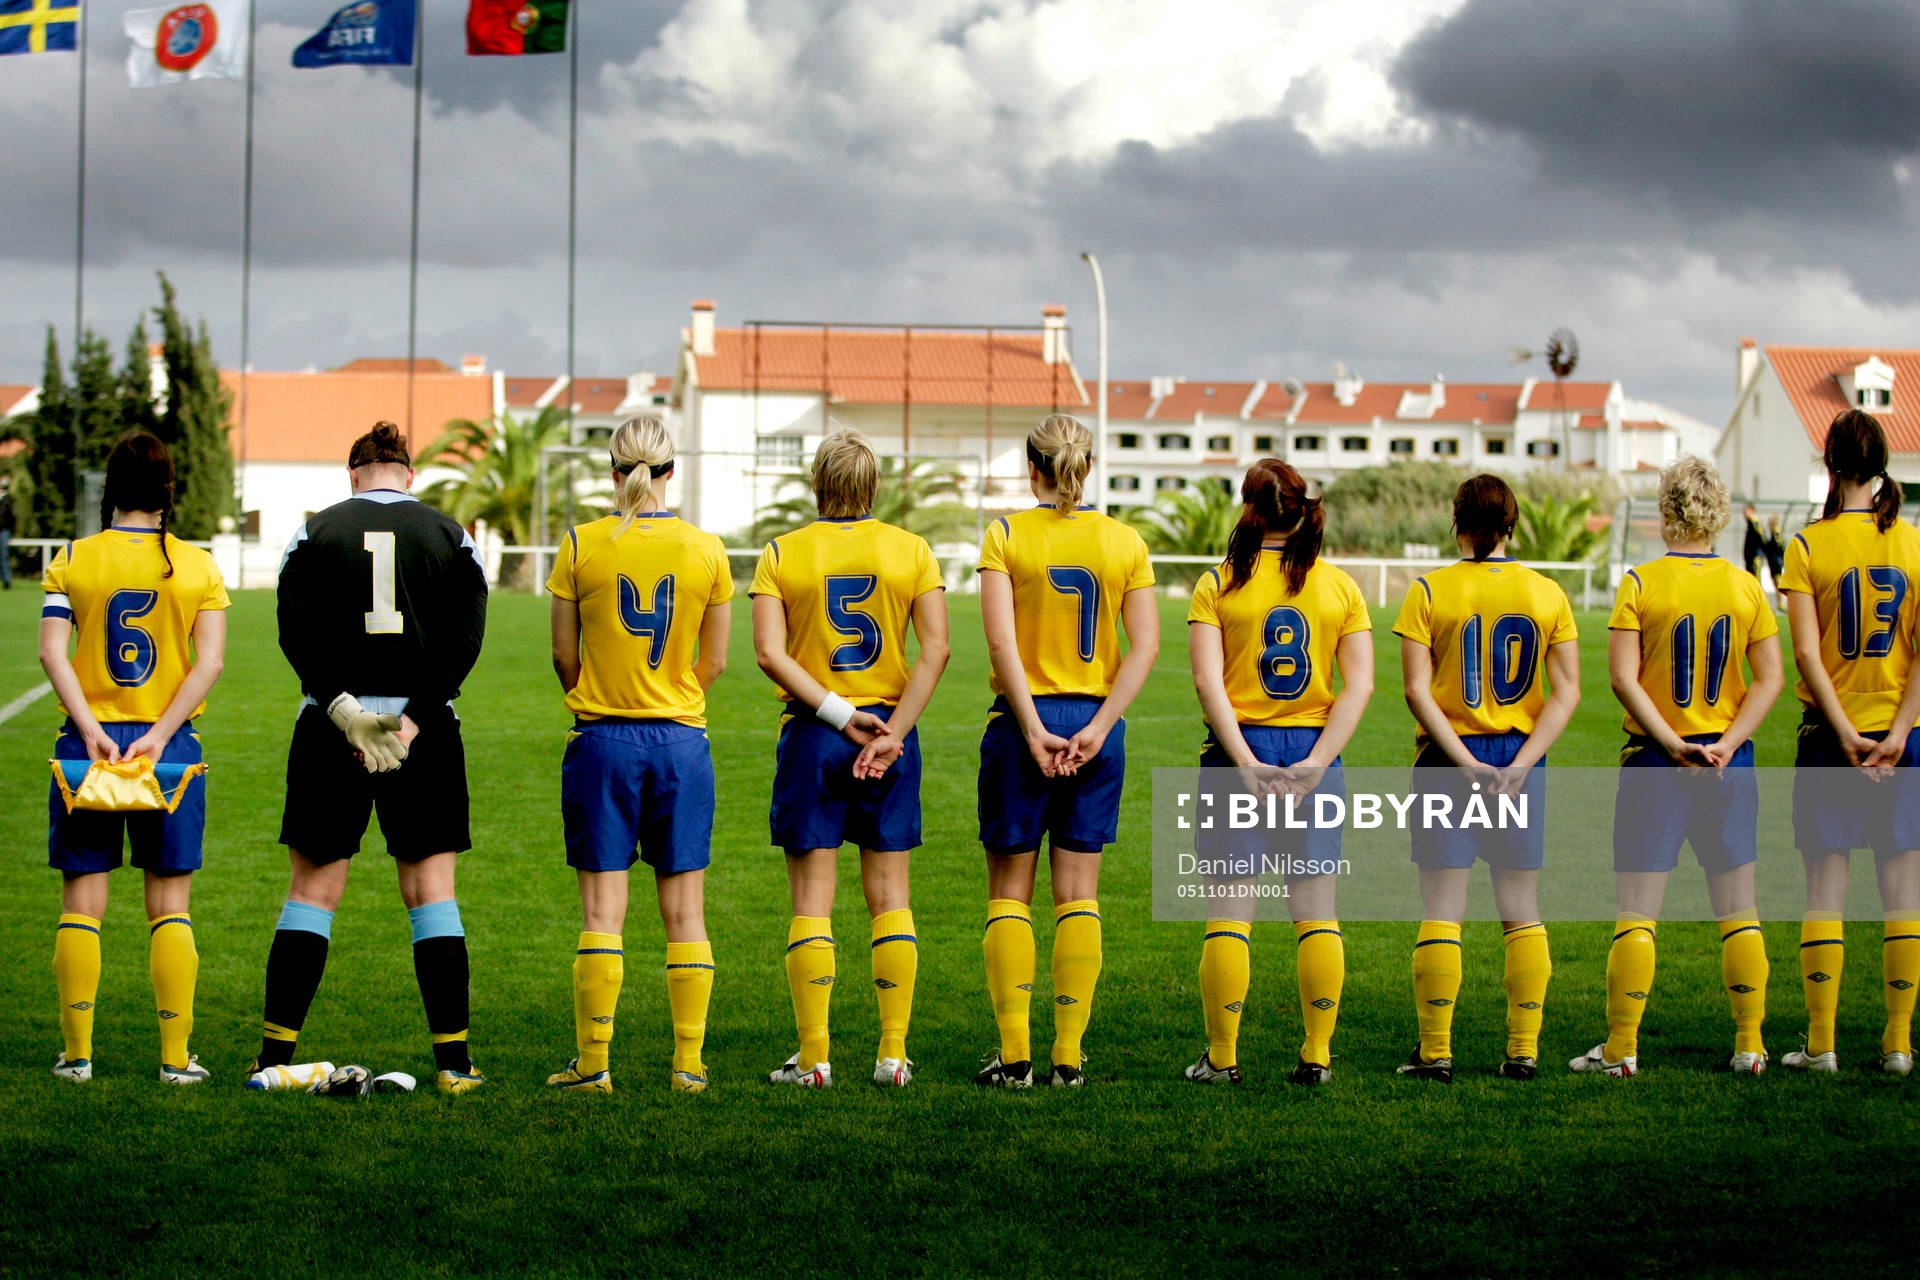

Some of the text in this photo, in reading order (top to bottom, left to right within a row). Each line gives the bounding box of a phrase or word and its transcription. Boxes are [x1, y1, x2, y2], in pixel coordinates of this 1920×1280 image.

[363, 531, 404, 635] 1
[617, 573, 675, 670] 4
[824, 574, 883, 672] 5
[1046, 565, 1101, 663] 7
[1837, 565, 1909, 660] 13
[104, 588, 158, 687] 6
[1257, 605, 1312, 700] 8
[1460, 613, 1540, 709] 10
[1671, 613, 1732, 708] 11
